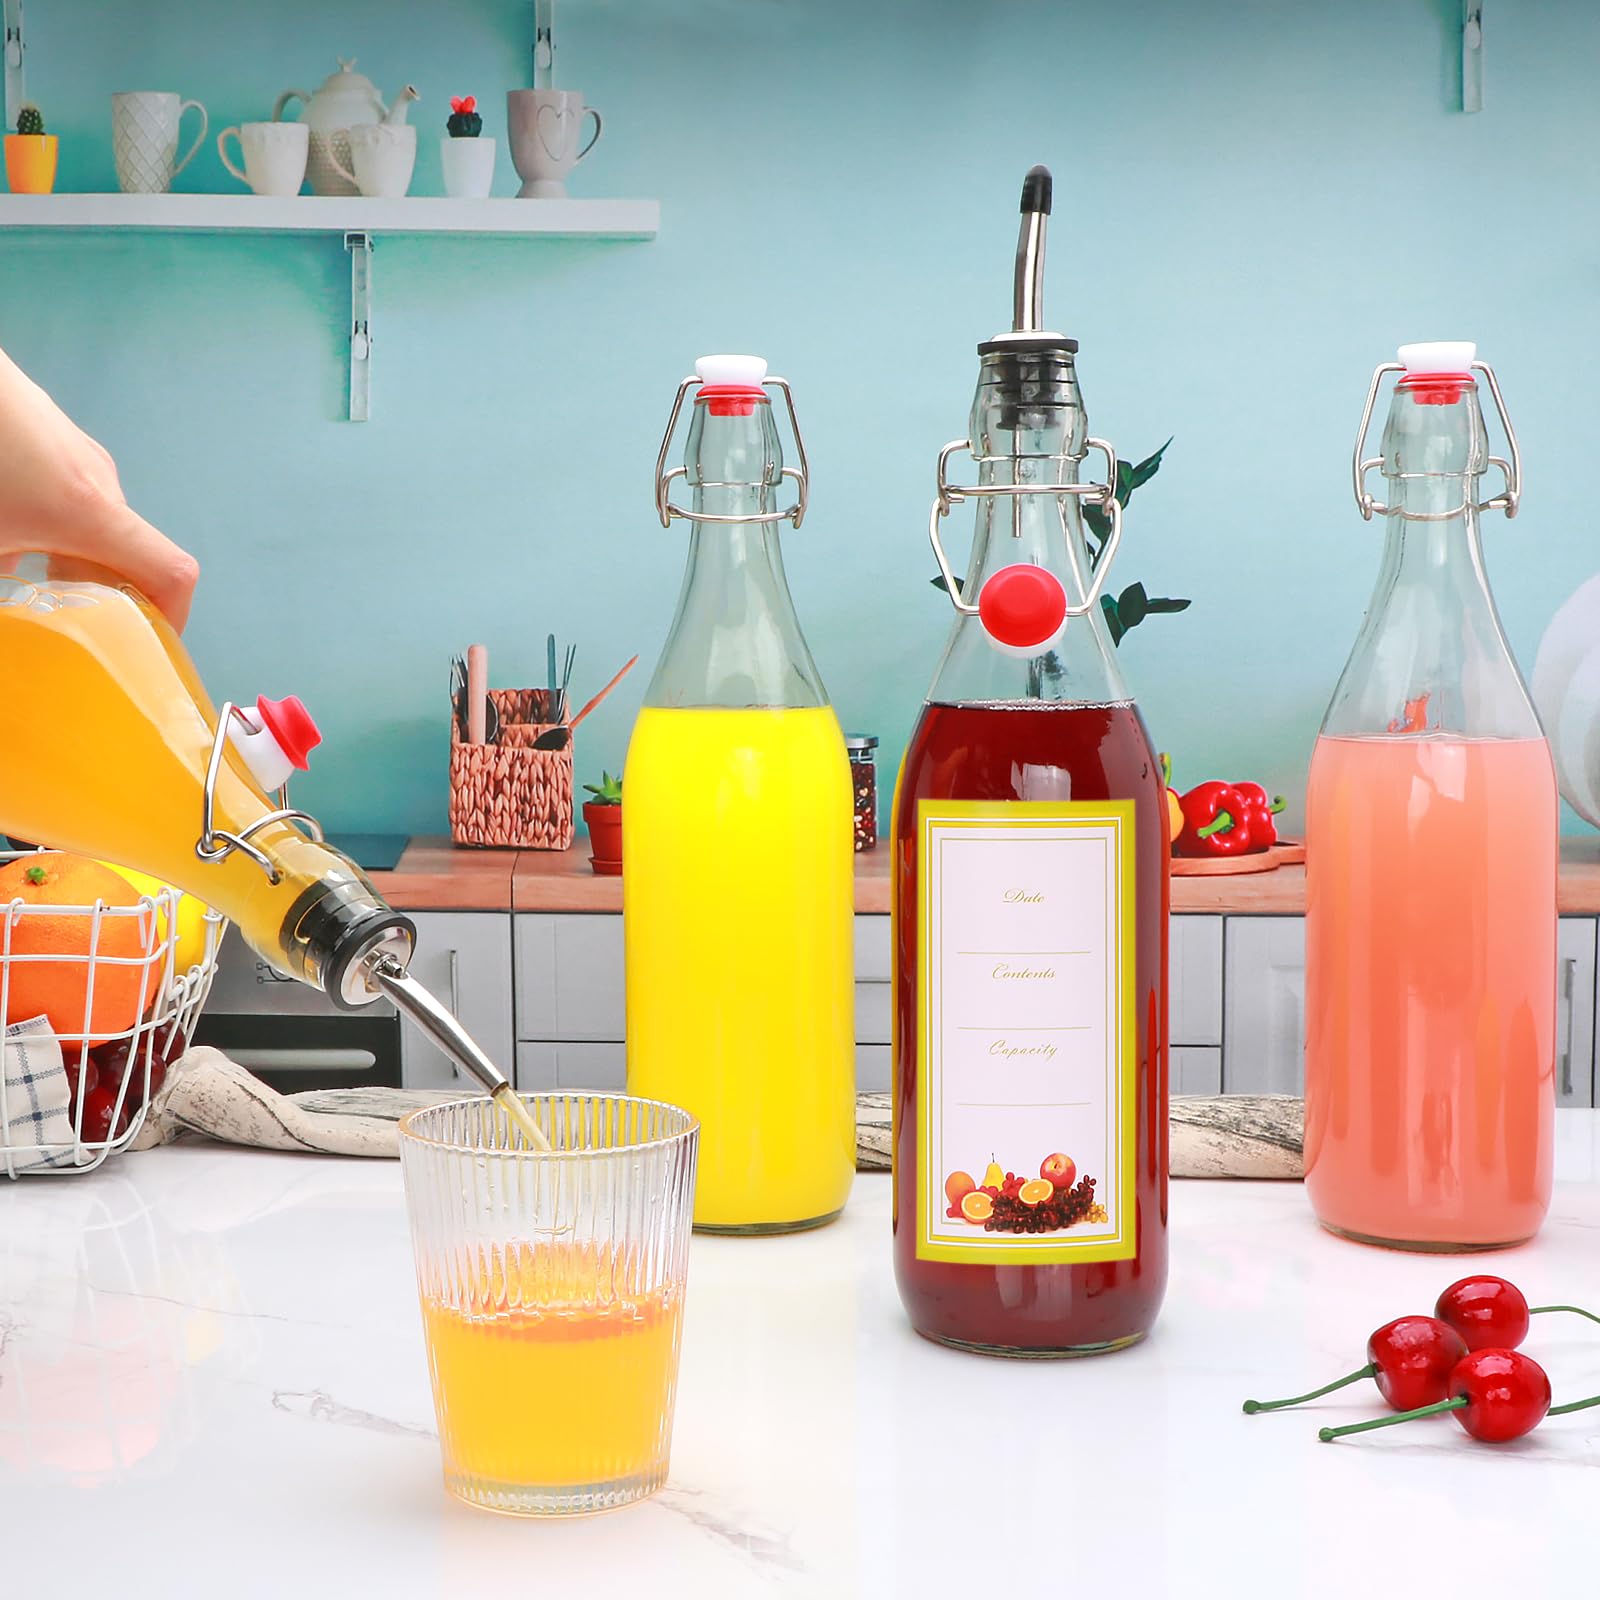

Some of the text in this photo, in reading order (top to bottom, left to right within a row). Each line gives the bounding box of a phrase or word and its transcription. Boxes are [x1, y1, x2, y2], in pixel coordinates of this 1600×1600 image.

[1003, 888, 1045, 904] Date
[992, 962, 1056, 979] Contents
[989, 1039, 1058, 1061] Capacity
